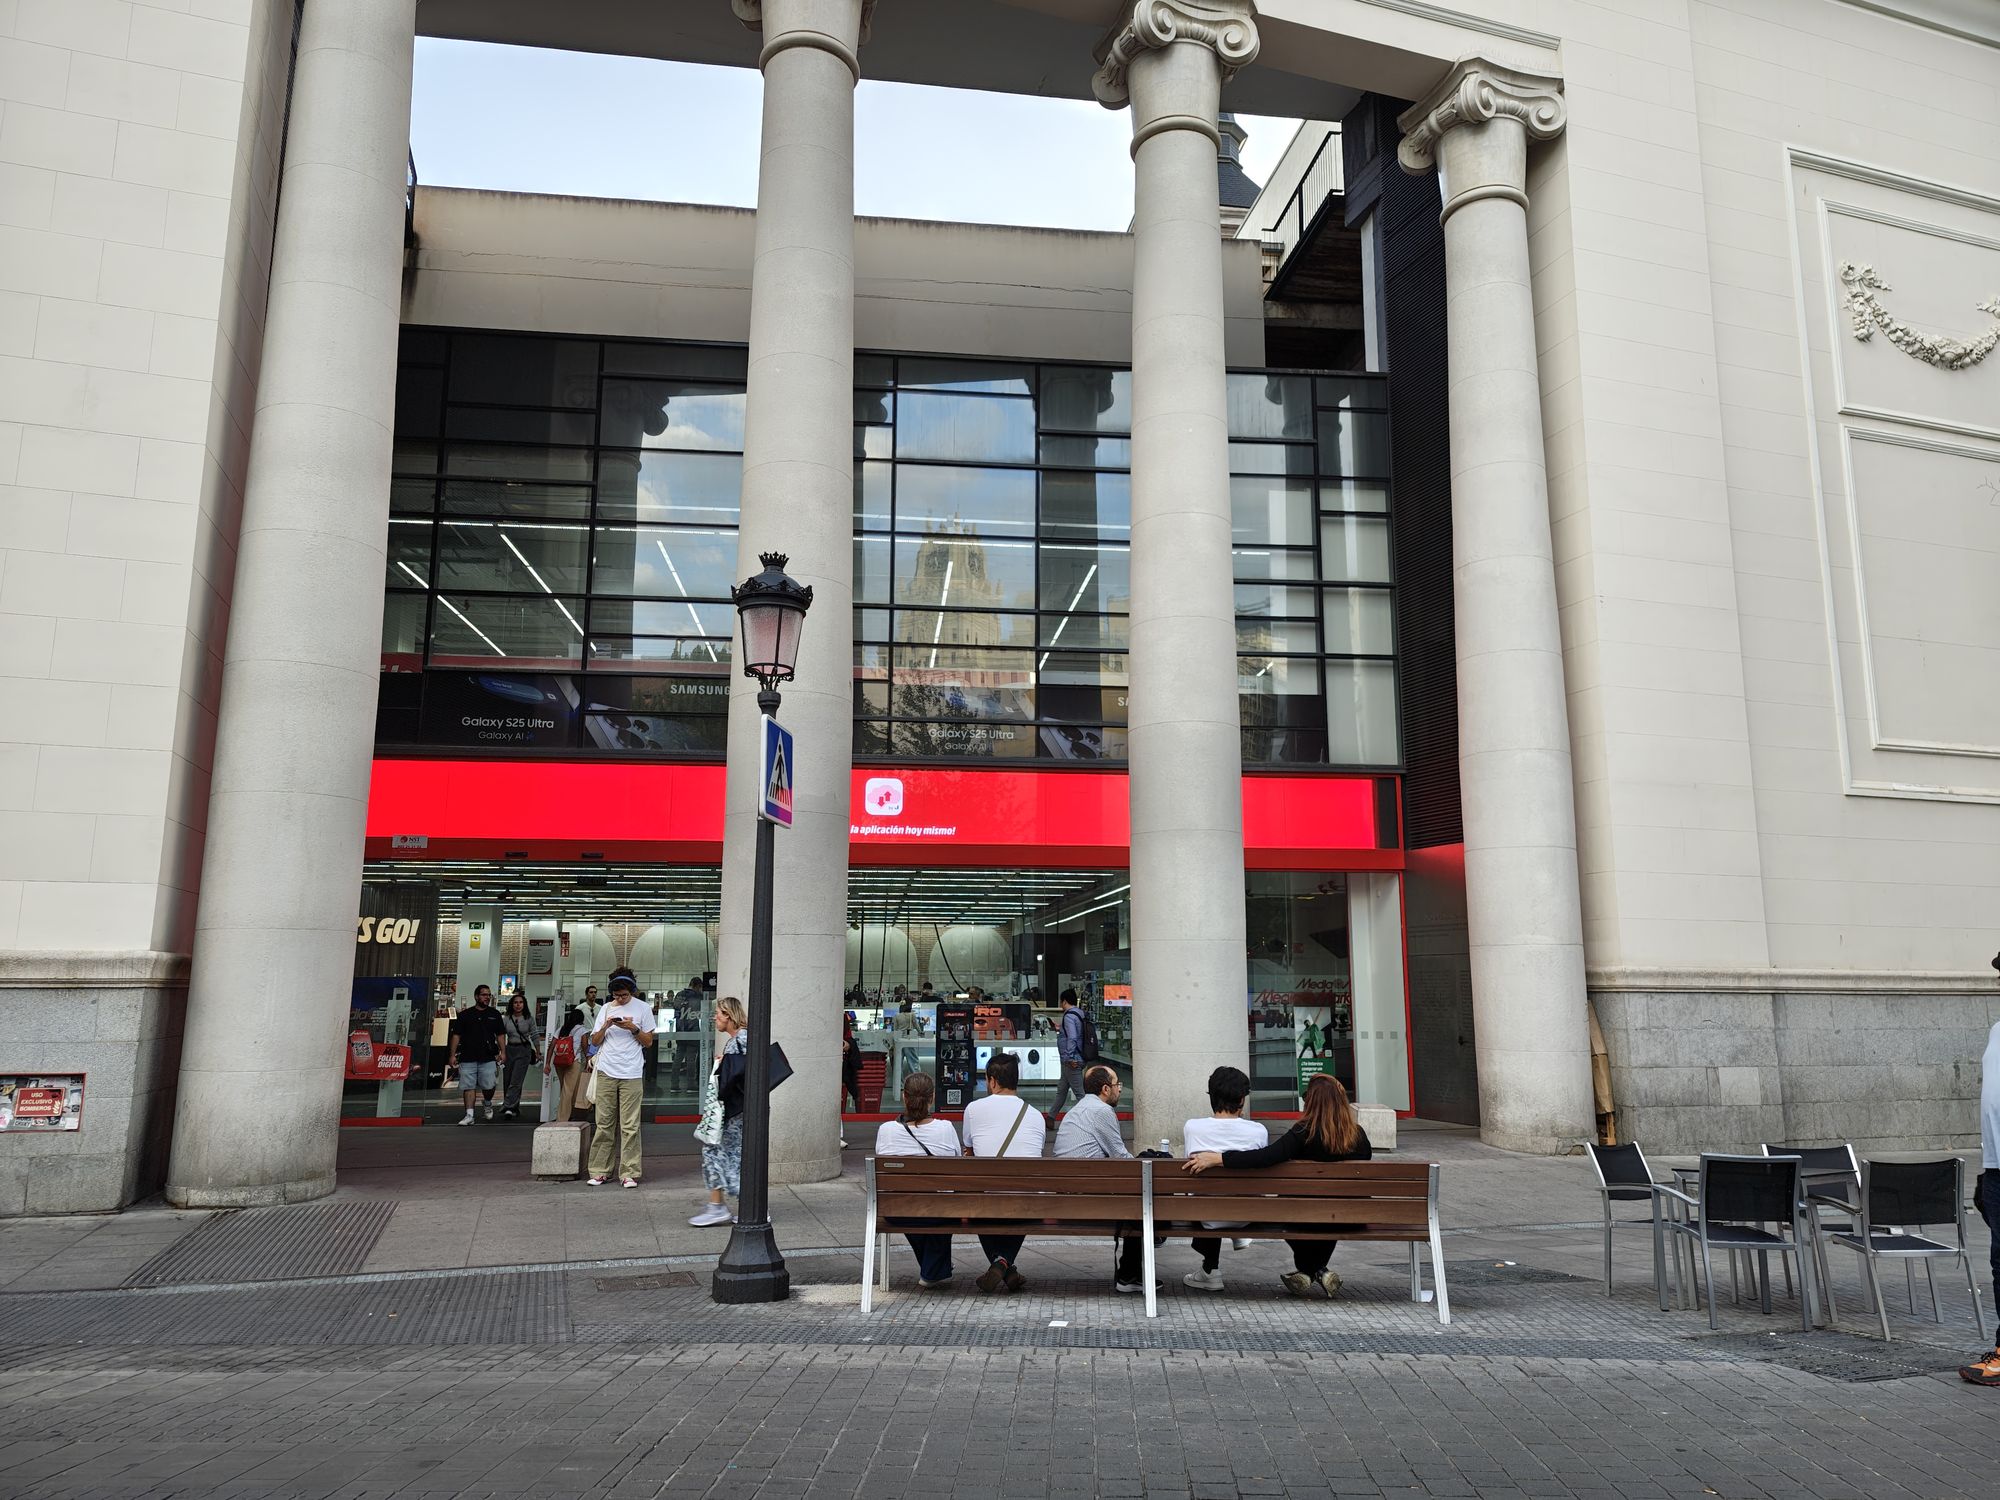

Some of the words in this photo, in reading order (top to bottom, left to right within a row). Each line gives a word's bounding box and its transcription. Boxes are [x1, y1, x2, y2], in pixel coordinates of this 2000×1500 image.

[670, 684, 731, 695] SAMSUNG
[461, 717, 504, 729] Galaxy
[506, 718, 525, 728] S25
[527, 718, 555, 729] Ultra
[478, 731, 513, 741] Galaxy
[515, 732, 524, 740] AI
[928, 728, 967, 740] Galaxy
[969, 729, 987, 739] S25
[989, 729, 1014, 739] Ultra
[944, 742, 976, 752] Galaxy
[859, 825, 904, 836] aplicación
[905, 826, 922, 837] hoy
[923, 826, 956, 836] mismo!
[375, 917, 420, 945] GO!
